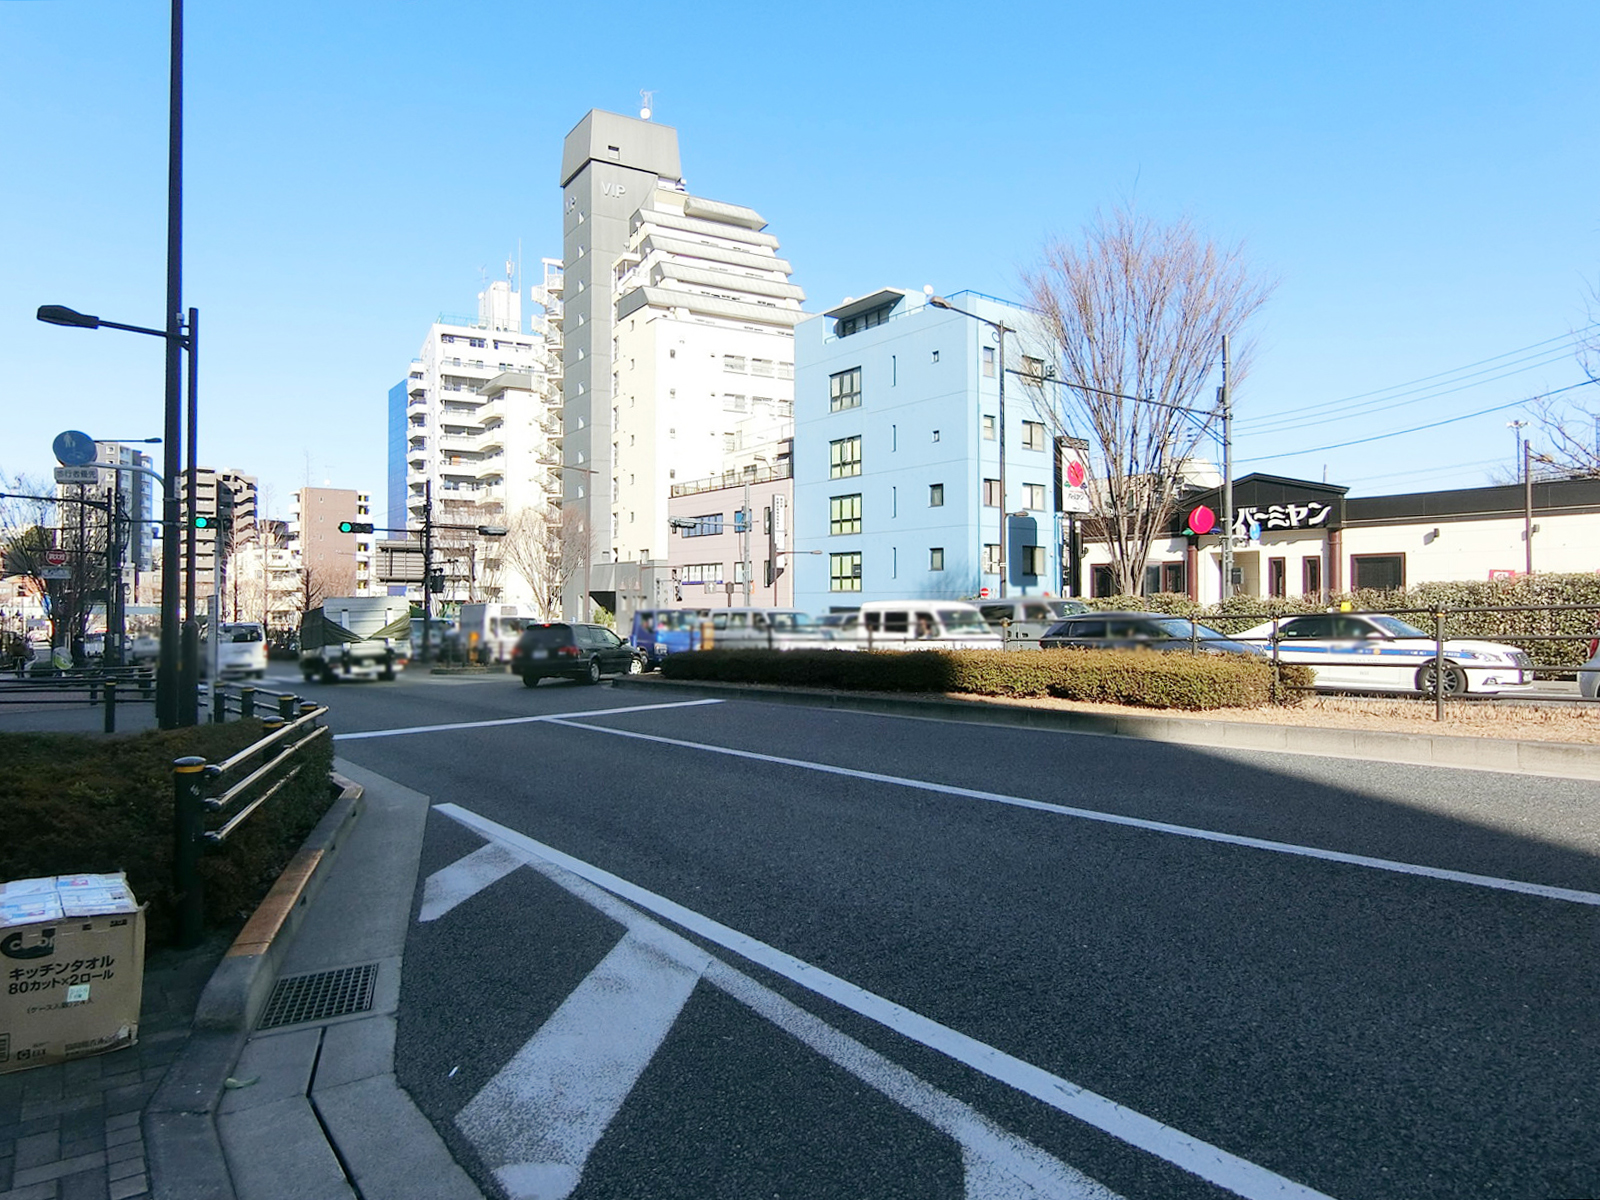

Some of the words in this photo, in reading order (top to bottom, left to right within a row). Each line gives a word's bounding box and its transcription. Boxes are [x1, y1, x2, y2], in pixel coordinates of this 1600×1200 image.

[601, 181, 626, 198] VIP
[1231, 502, 1332, 529] バーミヤン
[9, 955, 115, 981] キッチンタオル
